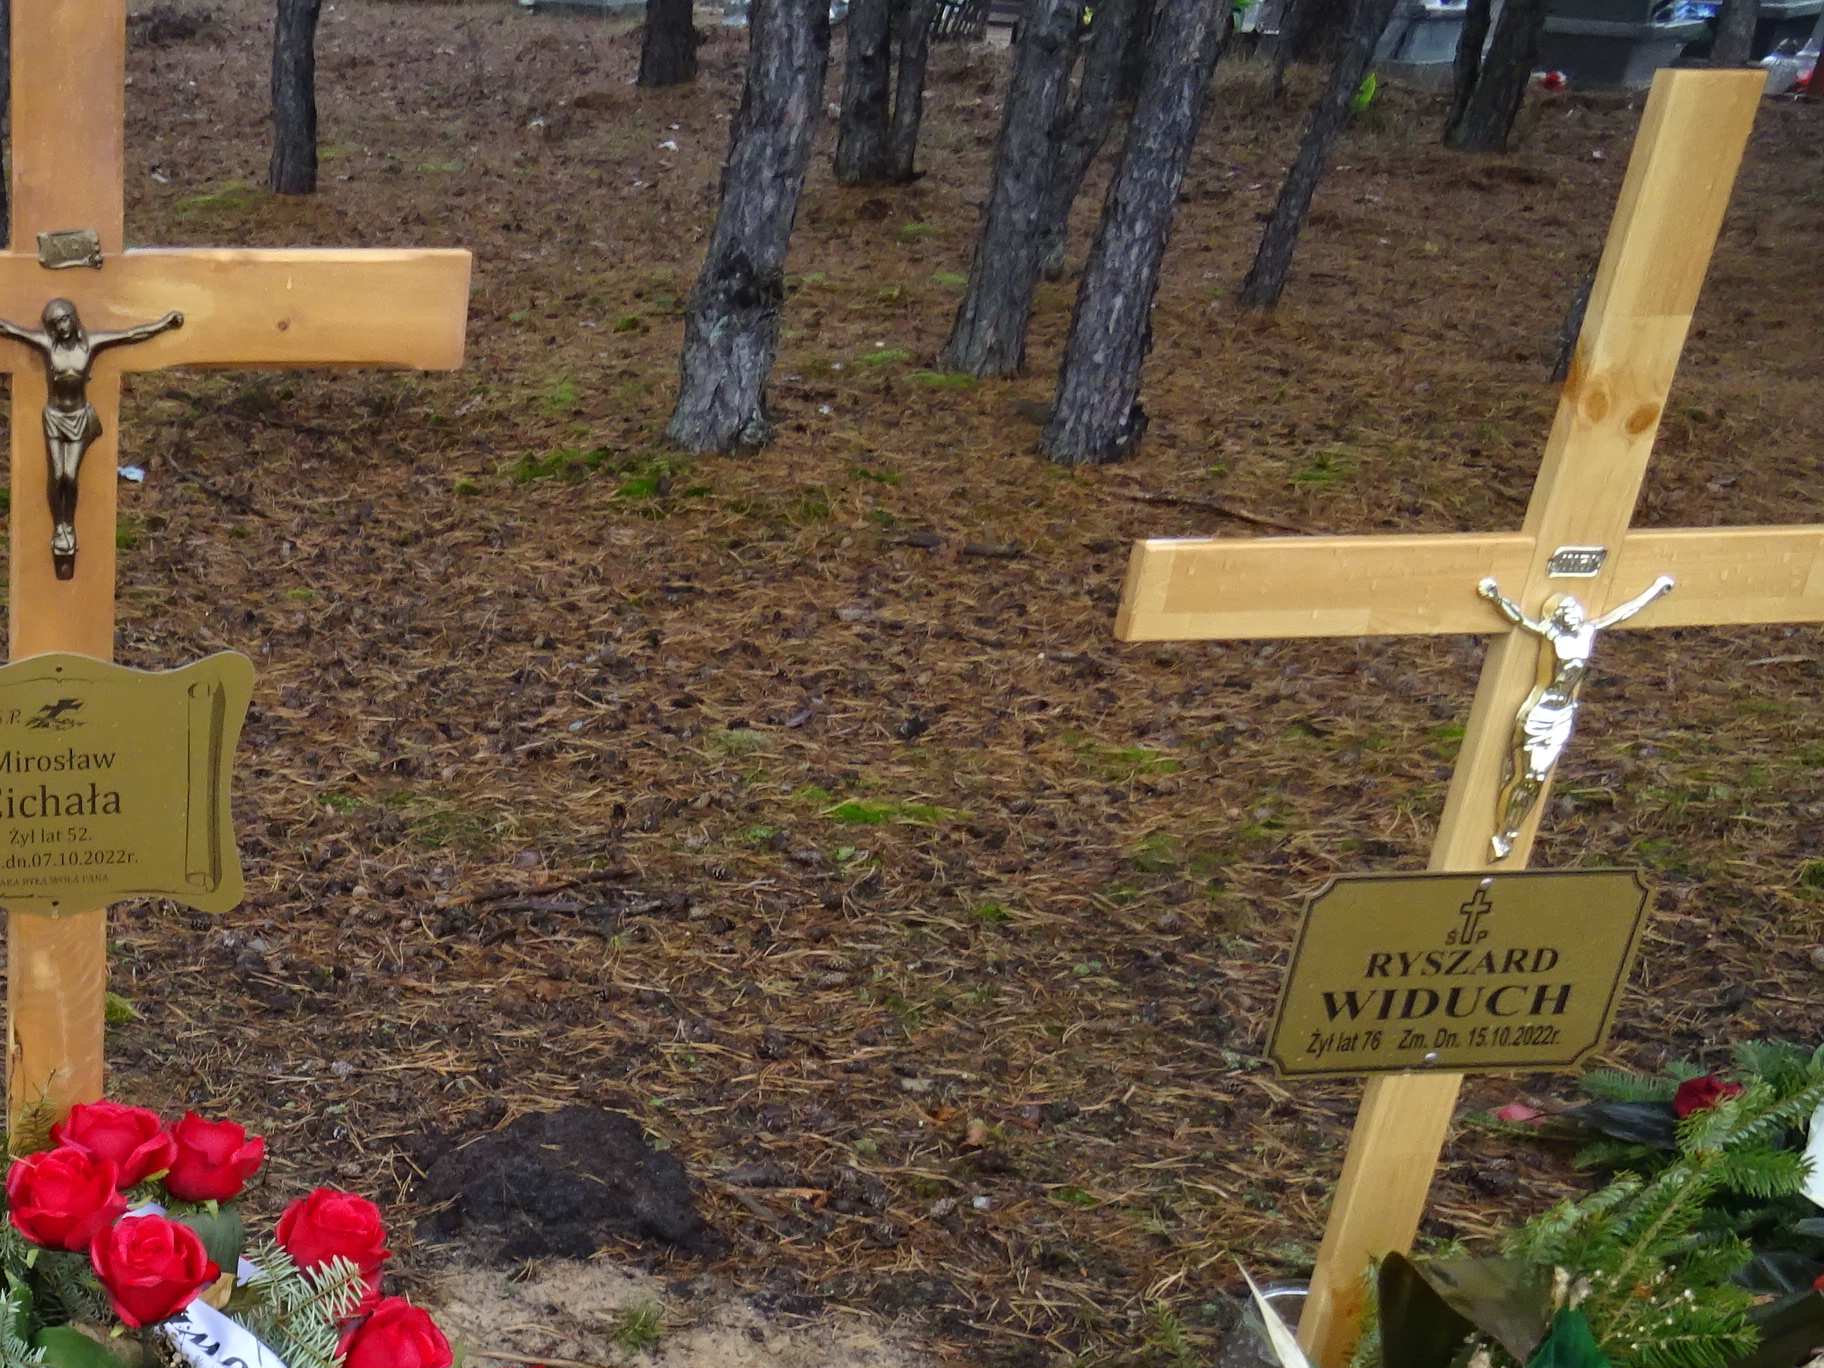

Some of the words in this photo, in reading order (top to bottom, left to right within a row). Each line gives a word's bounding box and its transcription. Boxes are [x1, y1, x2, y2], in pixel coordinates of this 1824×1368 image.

[41, 828, 61, 844] lat
[67, 826, 93, 843] 52.
[1363, 947, 1560, 979] RYSZARD
[1321, 983, 1573, 1023] WIDUCH
[1336, 1030, 1357, 1054] lat
[1361, 1029, 1383, 1052] 76
[1397, 1029, 1428, 1051] Zm.
[1433, 1027, 1461, 1049] Dn.
